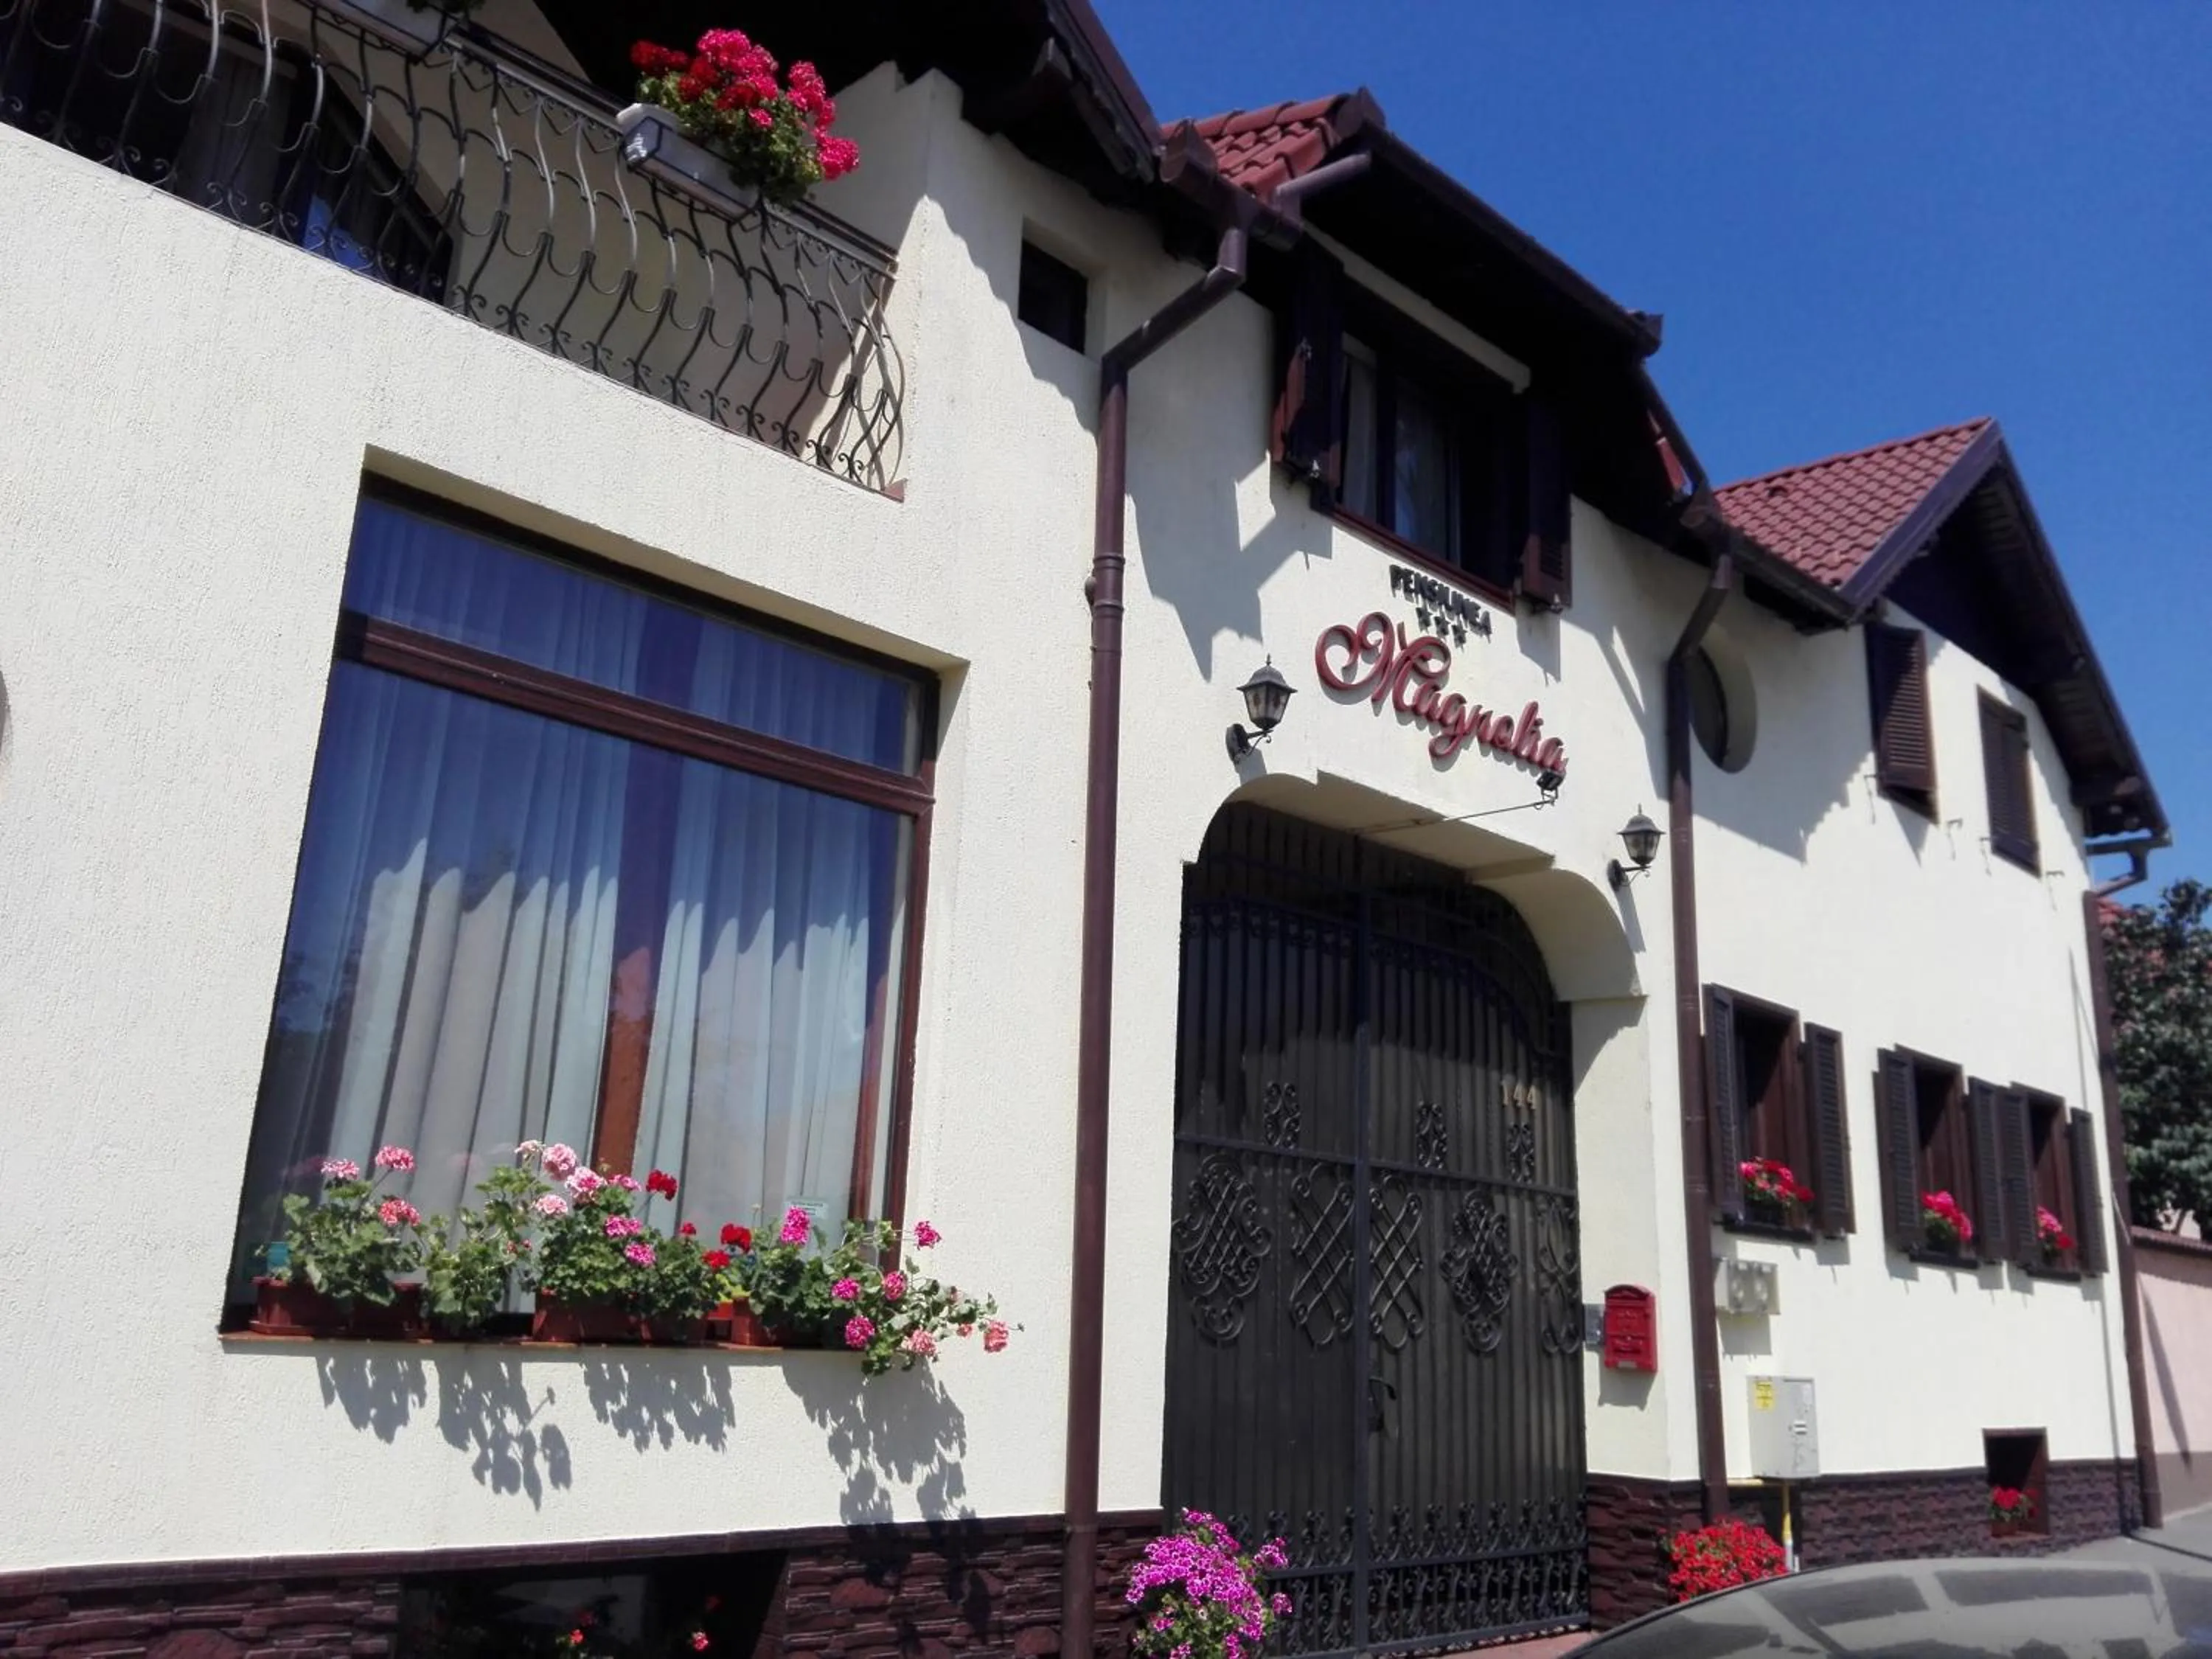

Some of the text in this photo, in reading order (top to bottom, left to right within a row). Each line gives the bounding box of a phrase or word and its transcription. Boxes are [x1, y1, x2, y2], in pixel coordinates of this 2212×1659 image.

[1389, 564, 1492, 636] PENSIUNEA
[1315, 611, 1568, 775] Magnolia
[1501, 1080, 1537, 1110] 144
